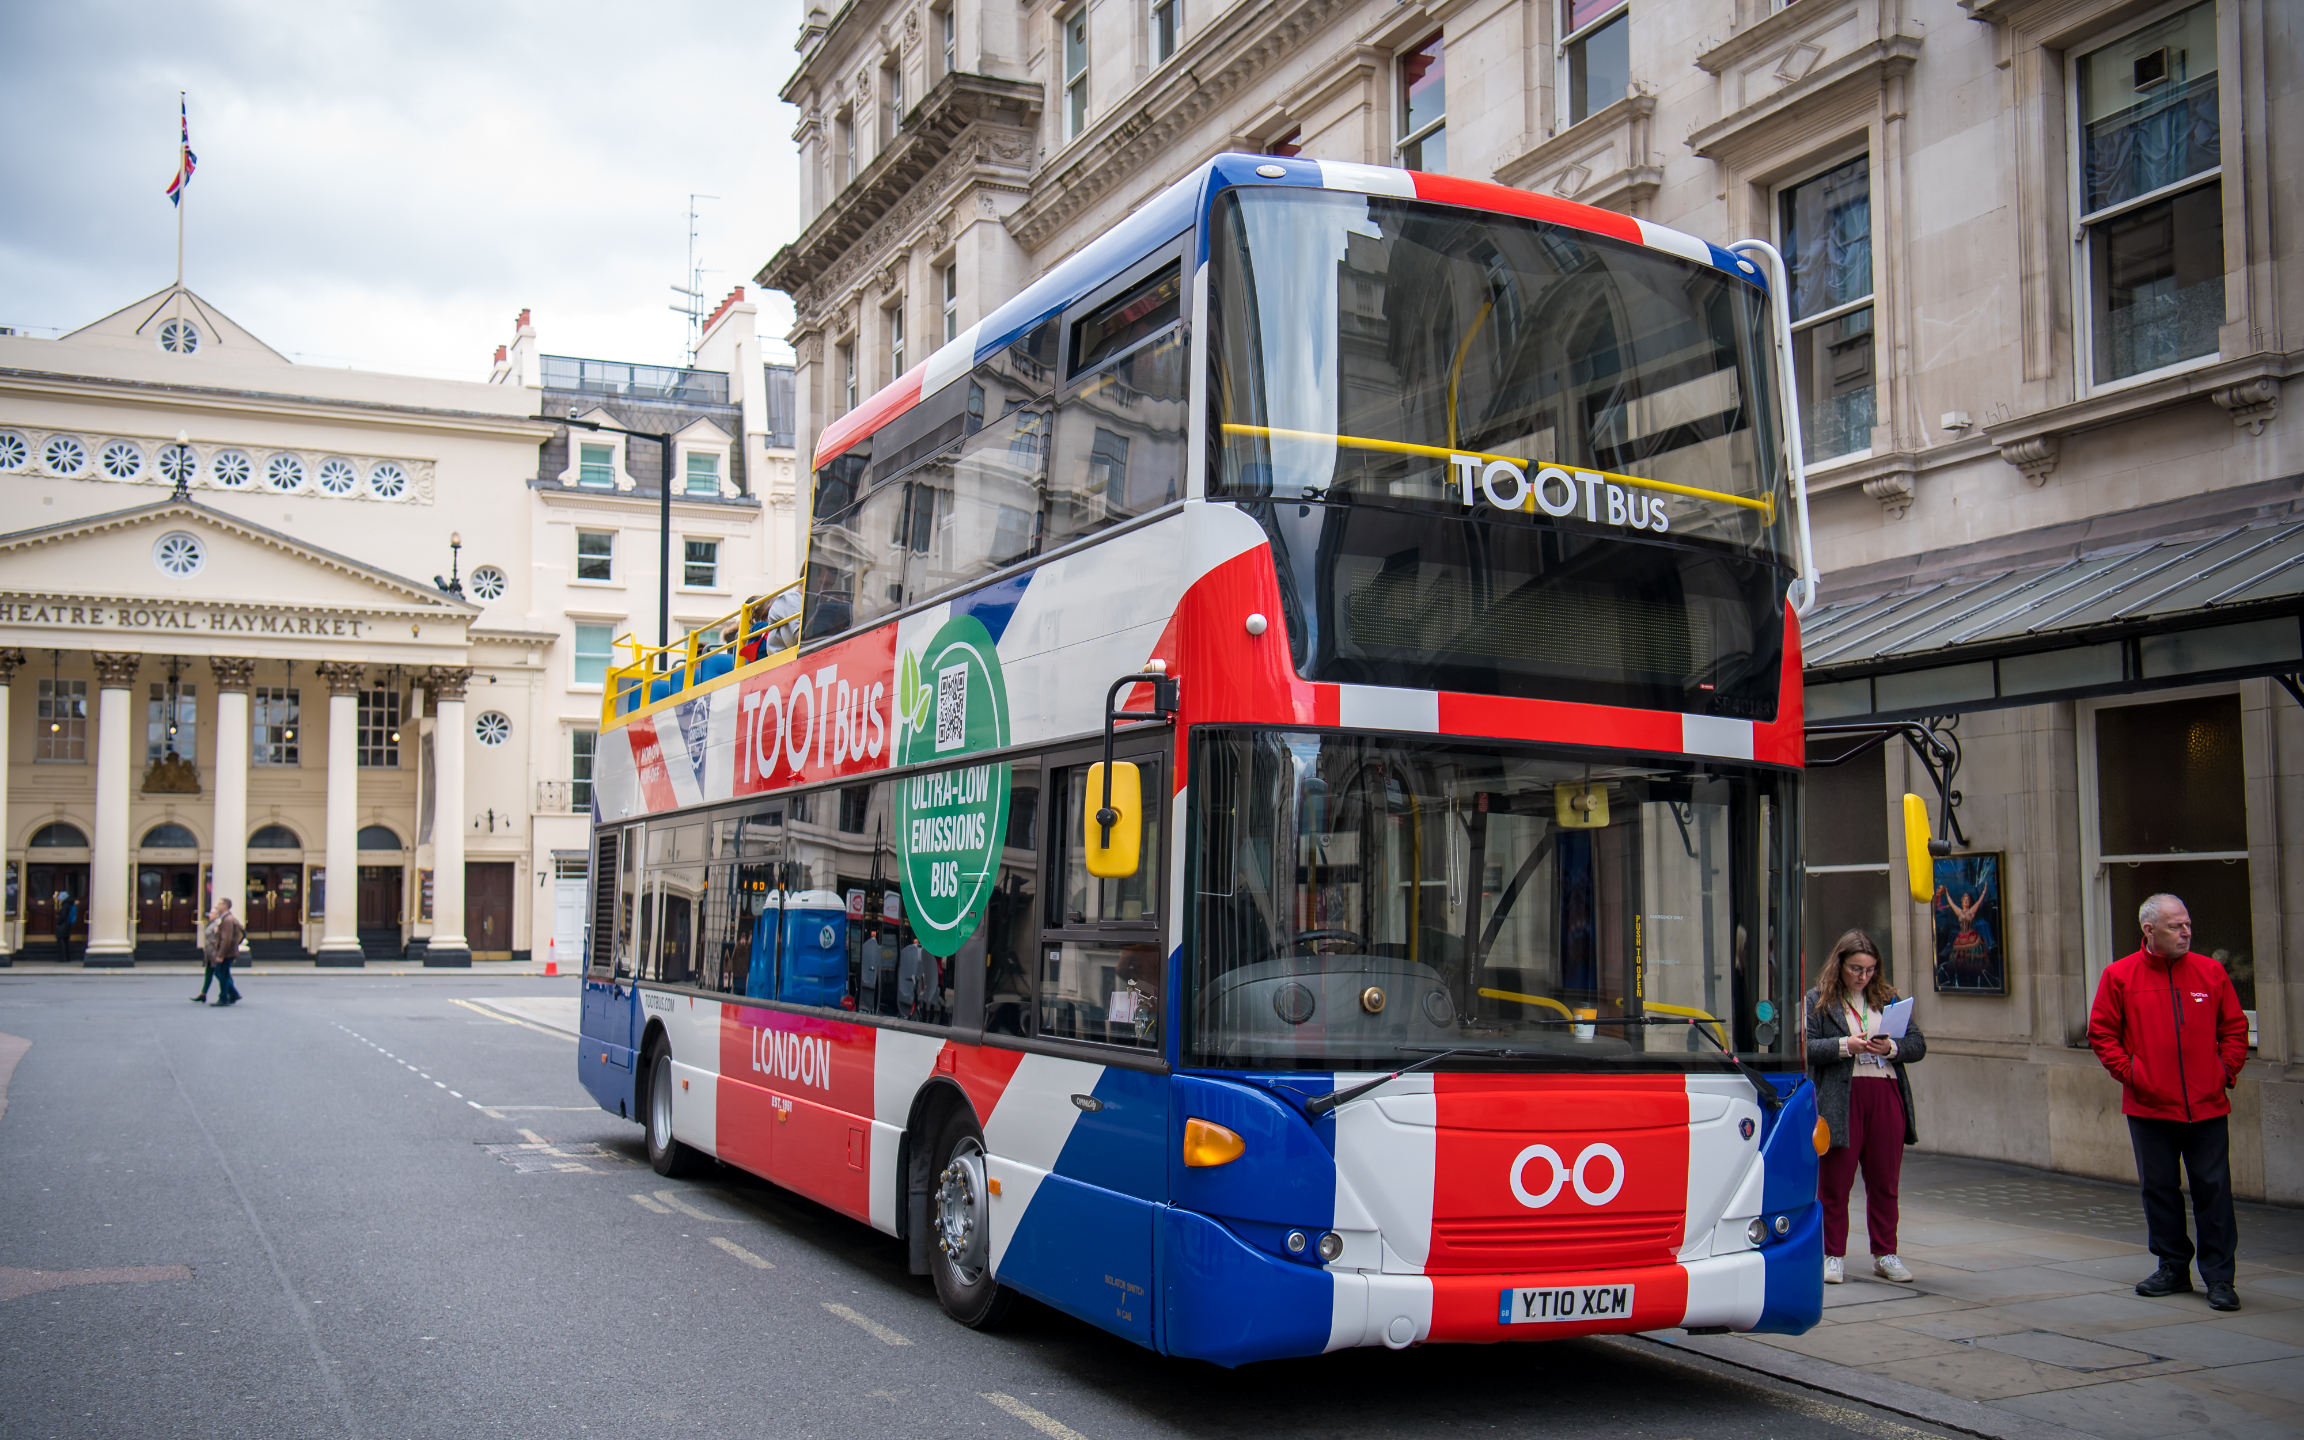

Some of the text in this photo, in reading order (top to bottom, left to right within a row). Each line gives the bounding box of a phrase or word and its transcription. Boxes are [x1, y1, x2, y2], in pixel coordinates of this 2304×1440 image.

[0, 603, 363, 637] HEATRE ROYAL HAYMARKET
[911, 765, 990, 811] ULTRA-LOW
[911, 811, 986, 854] EMISSIONS
[537, 871, 547, 888] 7
[930, 861, 959, 898] BUS
[1636, 948, 1641, 964] TO
[645, 994, 675, 1012] TOOTBUS.COM
[752, 1026, 830, 1091] LONDON
[1104, 1274, 1144, 1296] ISOLATOR SWITCH
[1522, 1288, 1627, 1317] YT10 XCM
